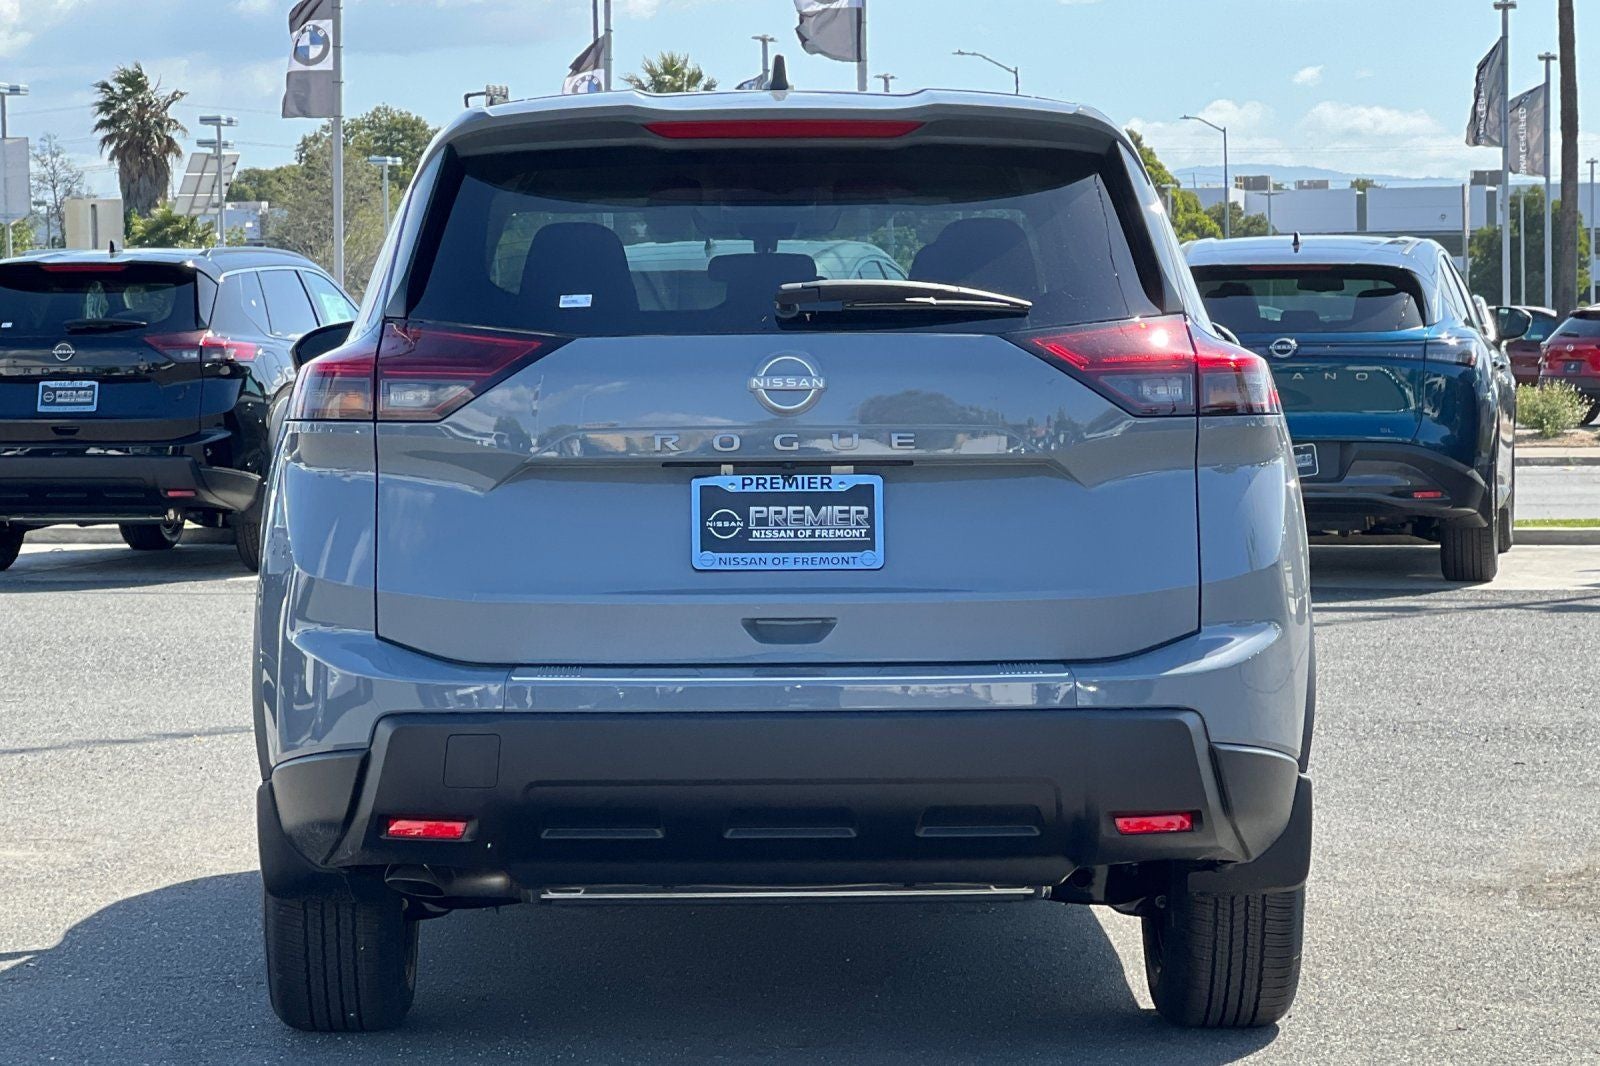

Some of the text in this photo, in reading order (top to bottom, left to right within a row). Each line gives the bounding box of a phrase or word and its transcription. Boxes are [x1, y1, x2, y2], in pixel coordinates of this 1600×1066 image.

[1292, 372, 1368, 380] ANO
[752, 377, 824, 388] NISSAN
[654, 432, 916, 451] ROGUE
[741, 476, 832, 490] PREMIER
[749, 506, 869, 527] PREMIER
[752, 529, 867, 538] NISSAN OF FREMONT
[718, 556, 858, 566] NISSAN OF FREMONT
